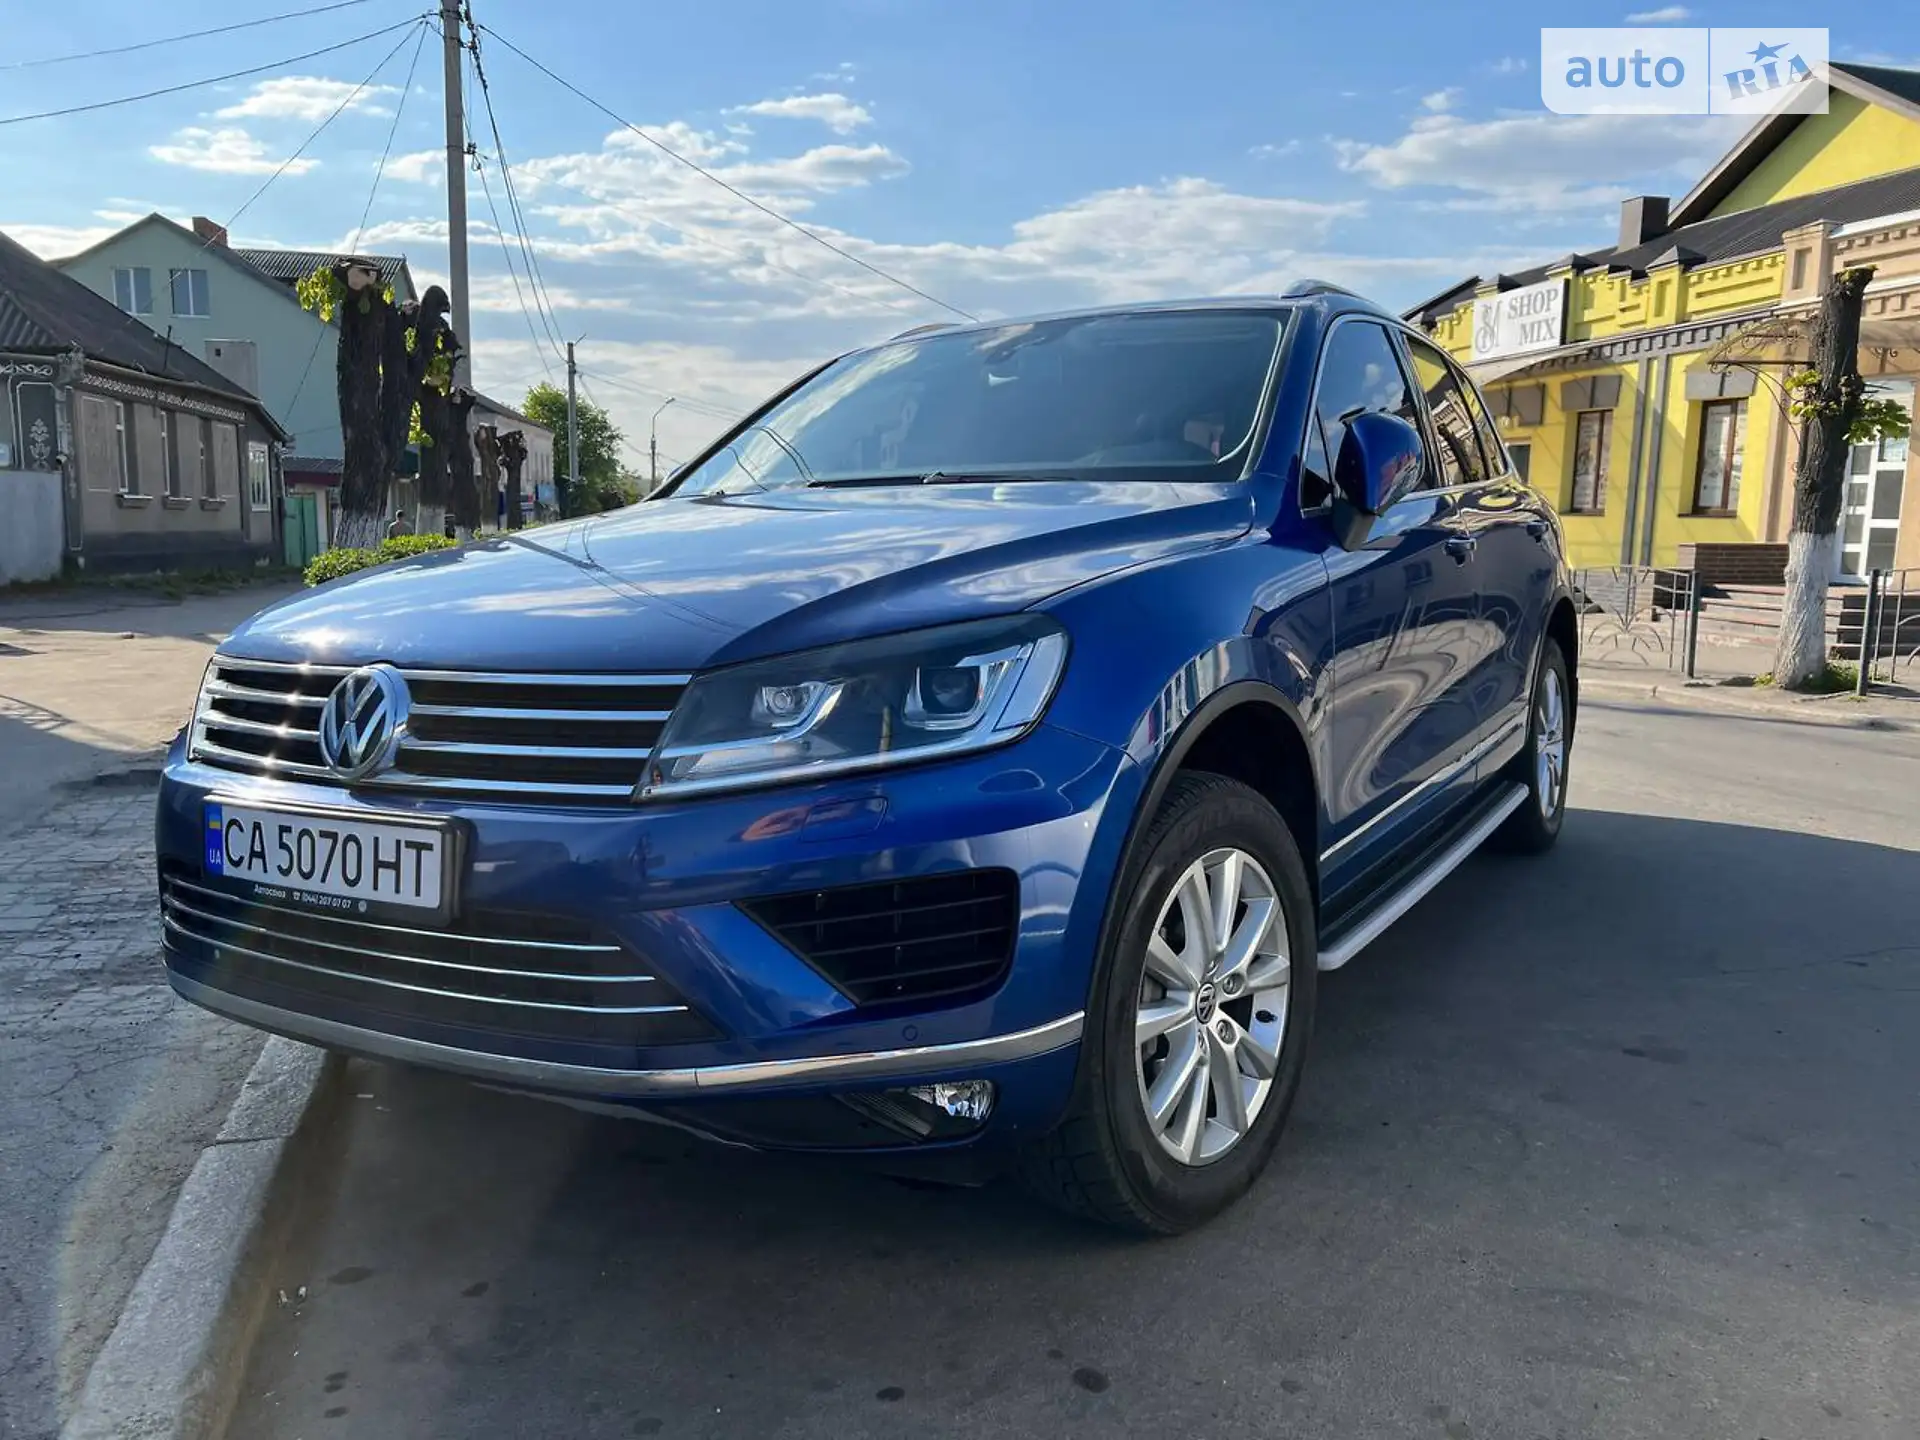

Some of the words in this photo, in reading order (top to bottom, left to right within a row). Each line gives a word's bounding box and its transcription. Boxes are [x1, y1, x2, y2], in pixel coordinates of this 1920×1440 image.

[1507, 288, 1559, 320] SHOP
[1518, 317, 1557, 346] MIX
[209, 848, 222, 865] UA
[224, 818, 268, 874] CA
[276, 824, 363, 888] 5070
[372, 836, 434, 897] HT
